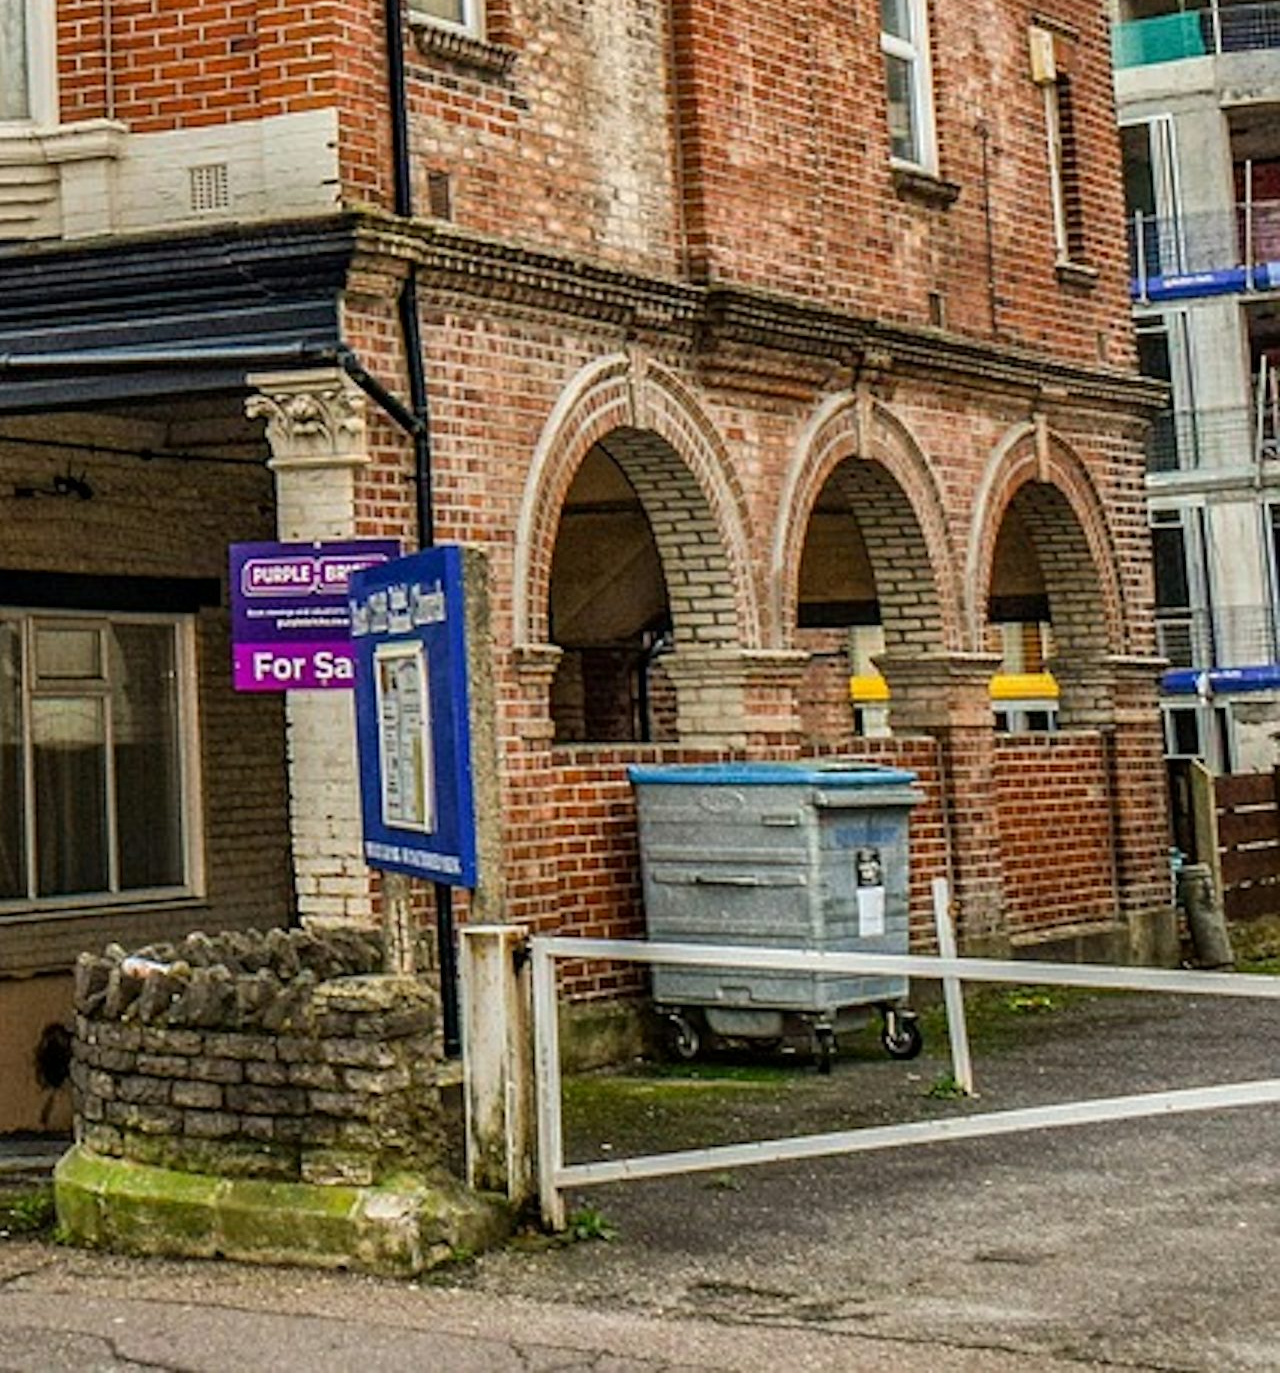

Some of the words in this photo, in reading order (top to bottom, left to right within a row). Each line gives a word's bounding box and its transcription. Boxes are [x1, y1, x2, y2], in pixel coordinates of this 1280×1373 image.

[252, 564, 311, 585] PURPLE
[252, 651, 307, 681] For
[313, 651, 355, 680] Sa
